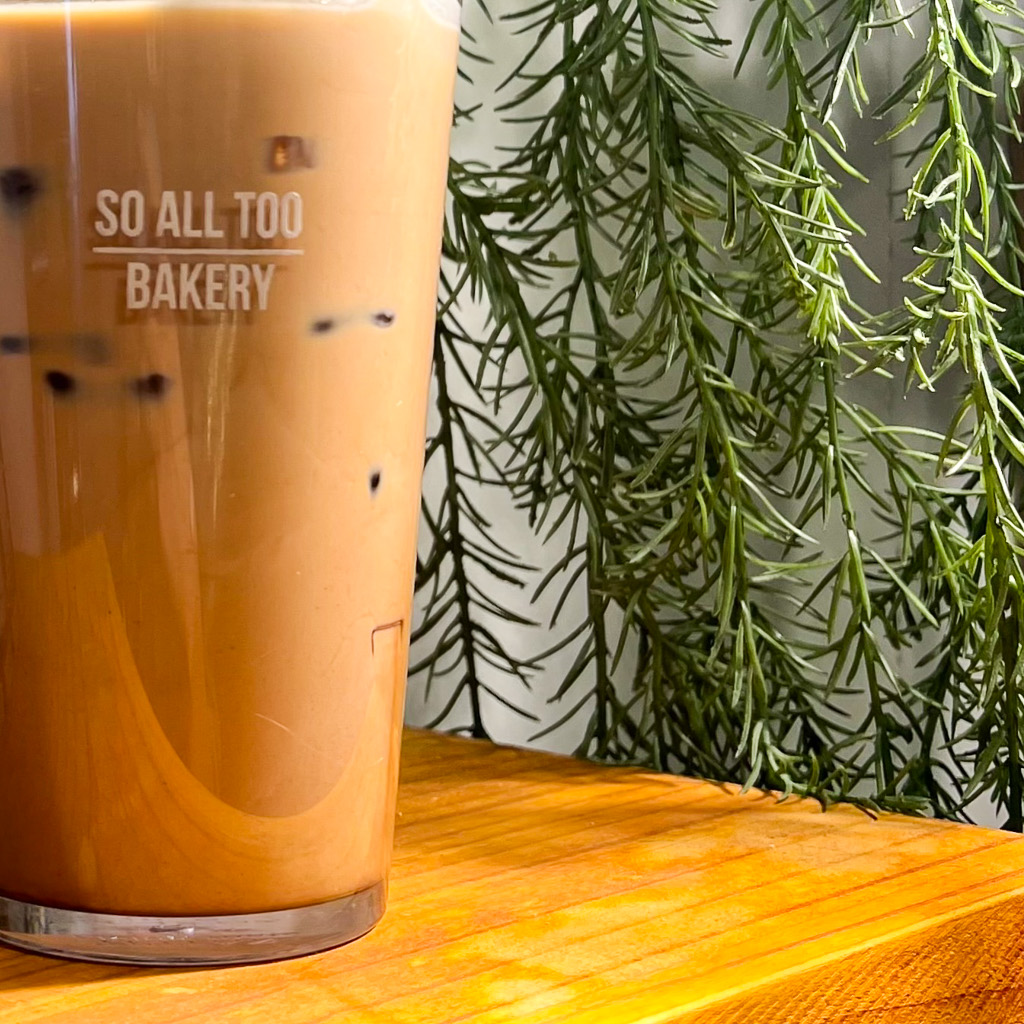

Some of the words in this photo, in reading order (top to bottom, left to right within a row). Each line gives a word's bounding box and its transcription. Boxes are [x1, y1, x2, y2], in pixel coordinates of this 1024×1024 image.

[94, 189, 145, 237] SO
[156, 190, 225, 239] ALL
[233, 191, 304, 240] TOO
[127, 261, 276, 311] BAKERY
